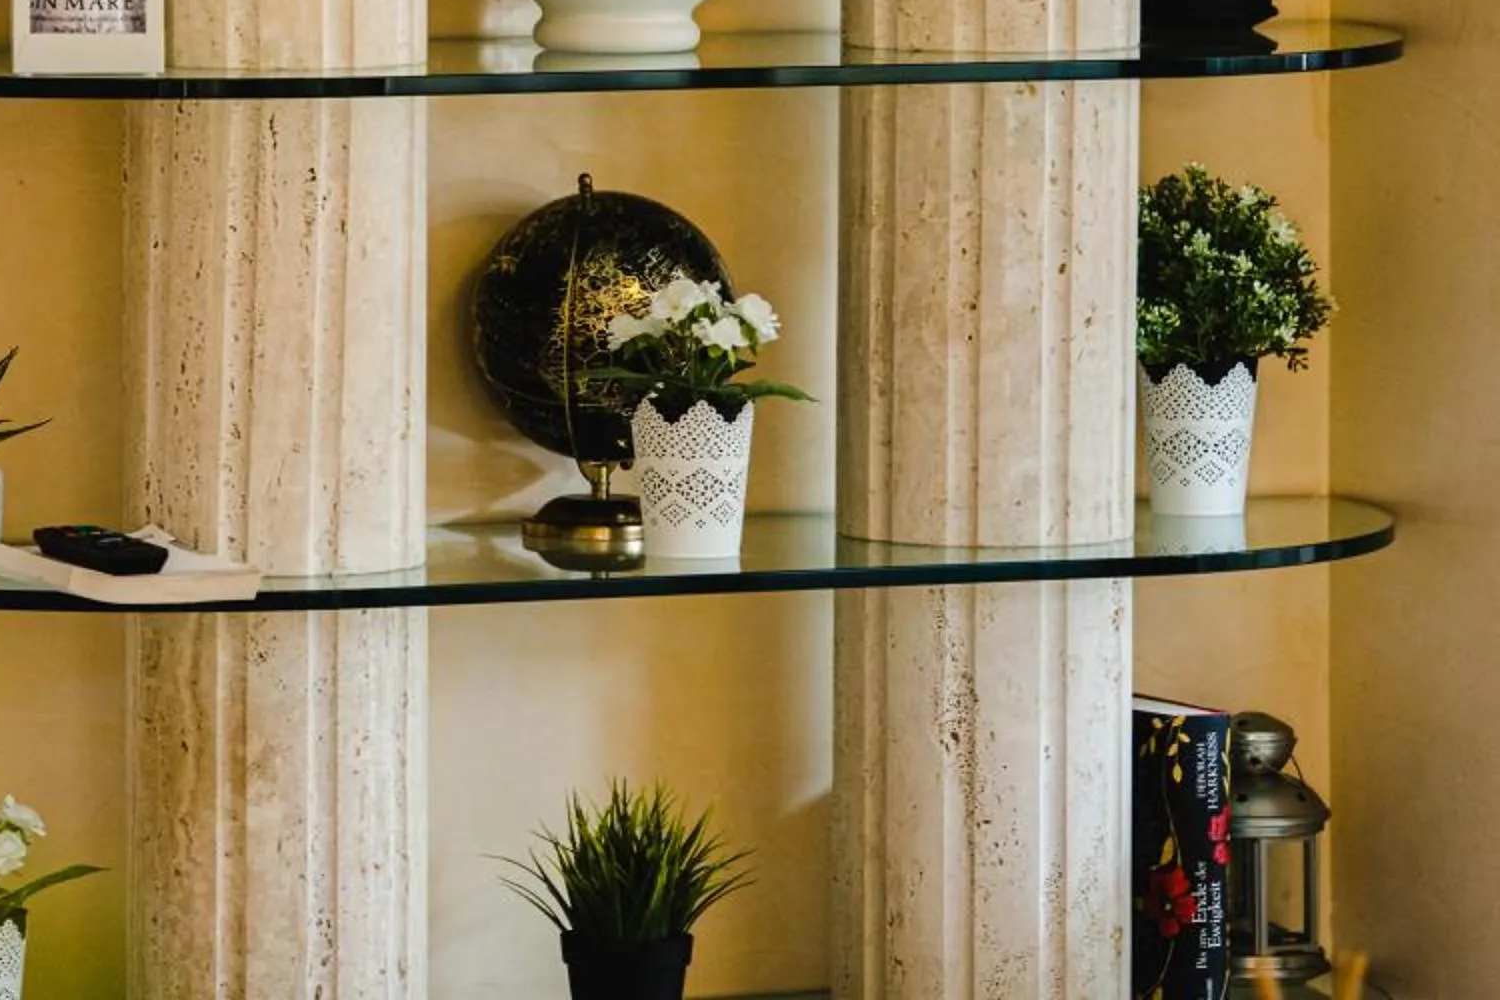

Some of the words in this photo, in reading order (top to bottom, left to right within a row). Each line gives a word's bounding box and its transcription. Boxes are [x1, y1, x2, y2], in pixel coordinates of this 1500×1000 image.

[1207, 730, 1218, 810] HARKNESS
[1192, 884, 1208, 924] Ende
[1207, 880, 1223, 949] Ewigkeit
